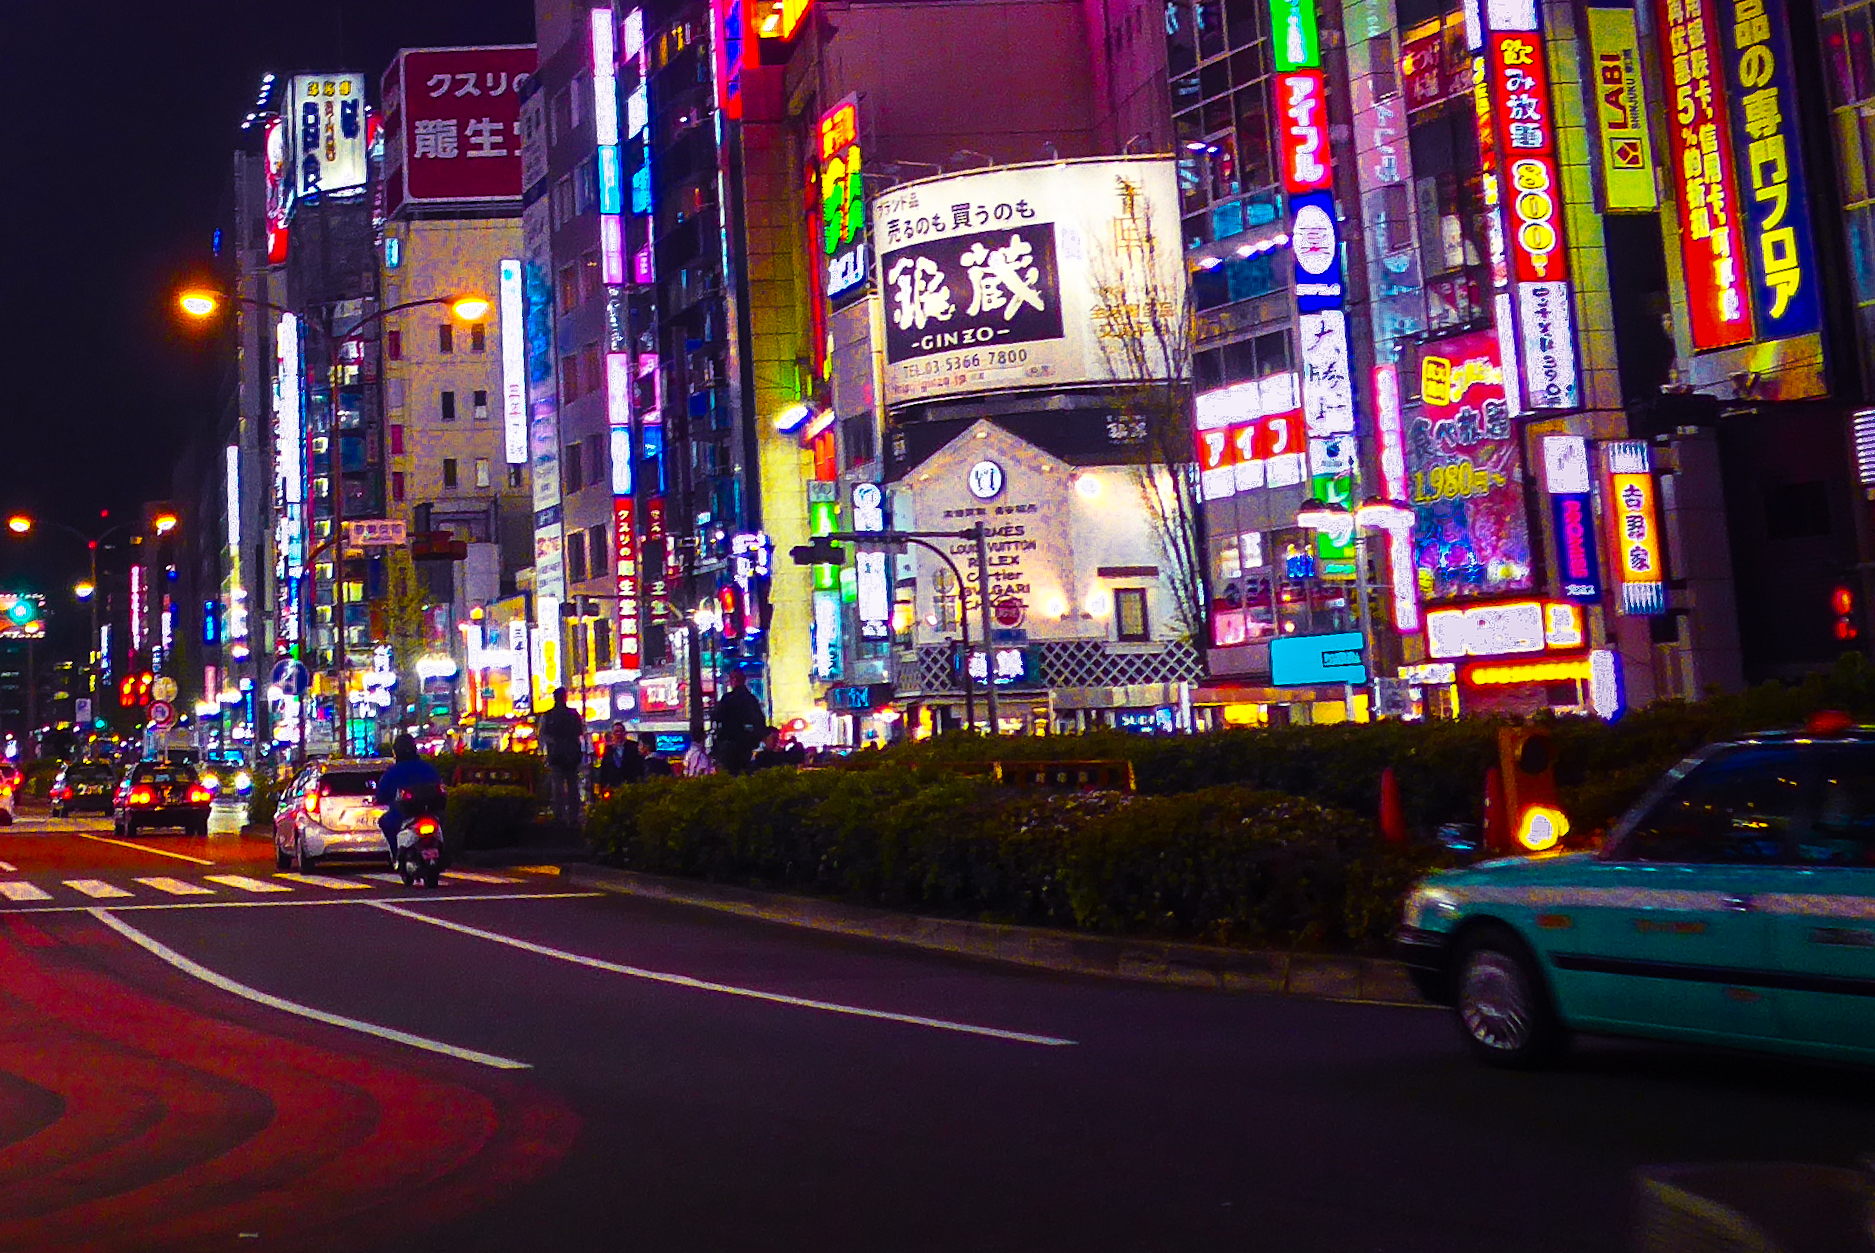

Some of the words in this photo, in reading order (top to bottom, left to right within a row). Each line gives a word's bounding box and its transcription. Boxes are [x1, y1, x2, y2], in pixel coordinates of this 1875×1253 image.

[1282, 76, 1325, 184] アイフル
[1500, 37, 1544, 150] 飲み放題
[1603, 53, 1626, 129] LABI
[414, 118, 521, 159] 龍生
[888, 234, 1045, 331] 銀蔵
[968, 556, 1020, 567] RLEX
[1620, 482, 1651, 571] 吉野家
